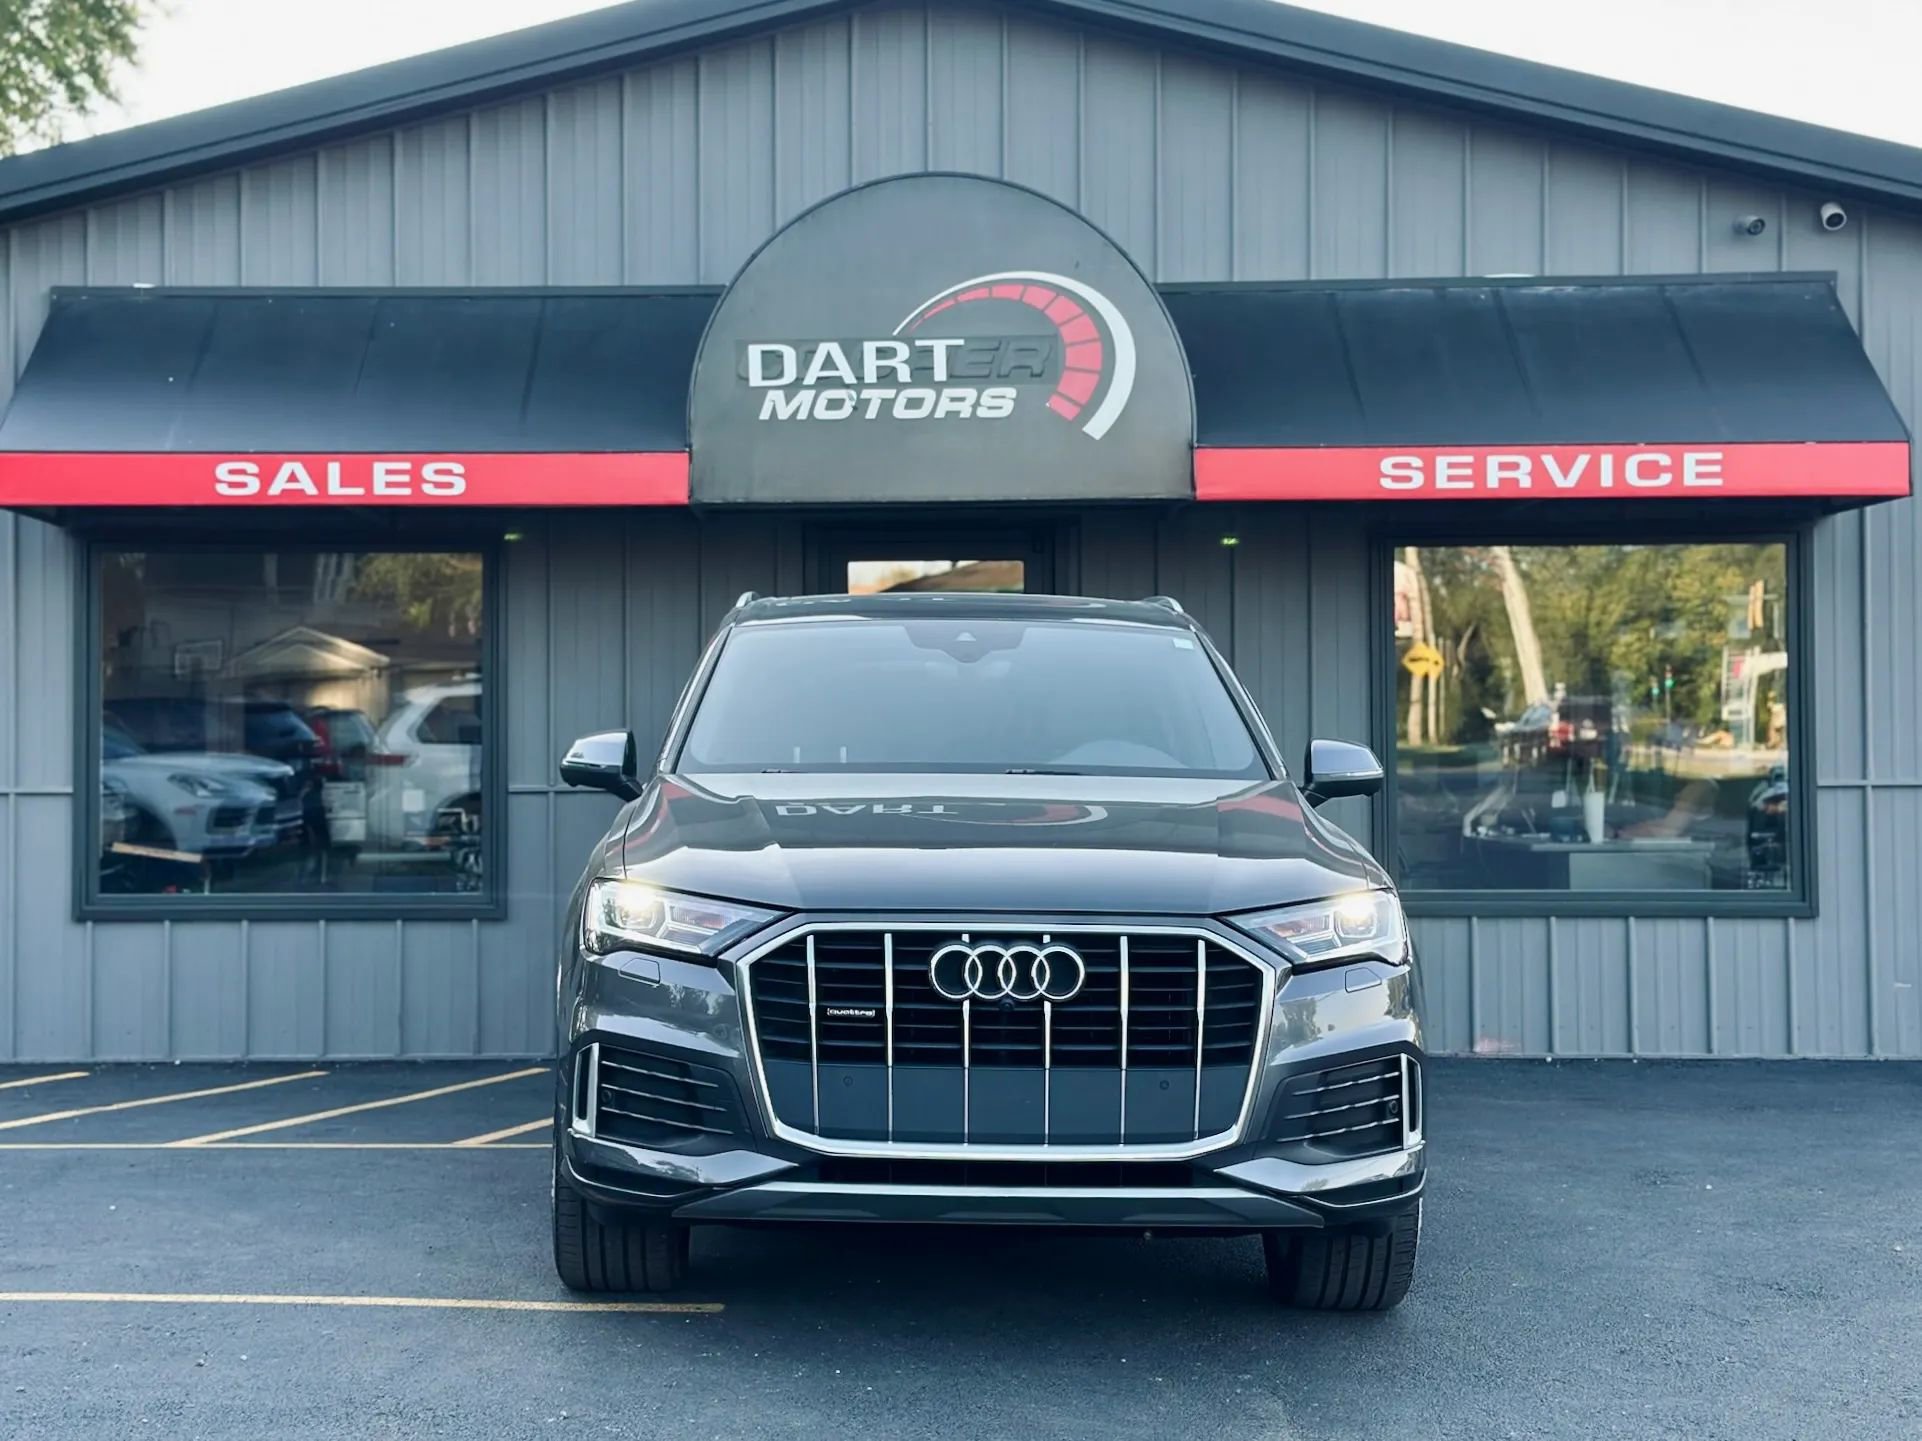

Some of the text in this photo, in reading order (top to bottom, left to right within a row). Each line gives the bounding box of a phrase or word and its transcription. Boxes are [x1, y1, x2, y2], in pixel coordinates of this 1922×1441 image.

[747, 339, 965, 387] DART
[758, 387, 1018, 421] MOTORS
[214, 461, 467, 496] SALES
[1379, 452, 1724, 490] SERVICE
